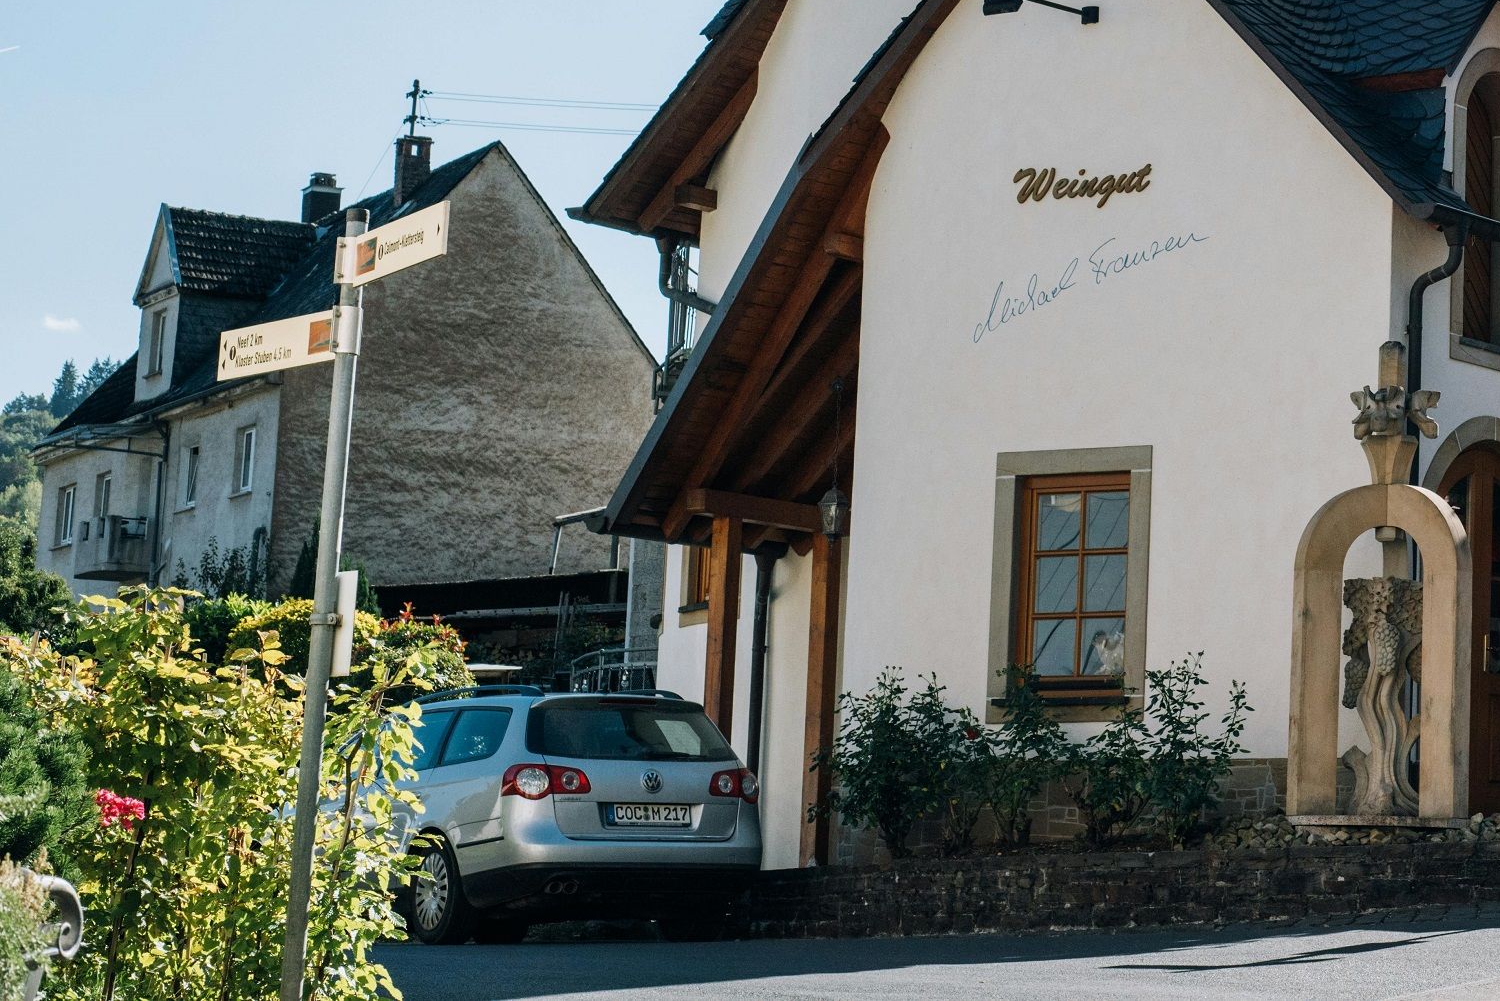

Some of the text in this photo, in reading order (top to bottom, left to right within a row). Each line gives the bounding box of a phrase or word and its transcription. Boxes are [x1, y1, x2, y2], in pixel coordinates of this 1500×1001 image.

[1013, 163, 1152, 209] Weingut
[237, 333, 263, 349] Neef 2 km
[235, 354, 254, 368] Kloster
[254, 350, 273, 365] Stuben
[282, 346, 292, 359] km
[615, 806, 643, 821] COC
[651, 807, 662, 821] M
[663, 807, 688, 821] 217
